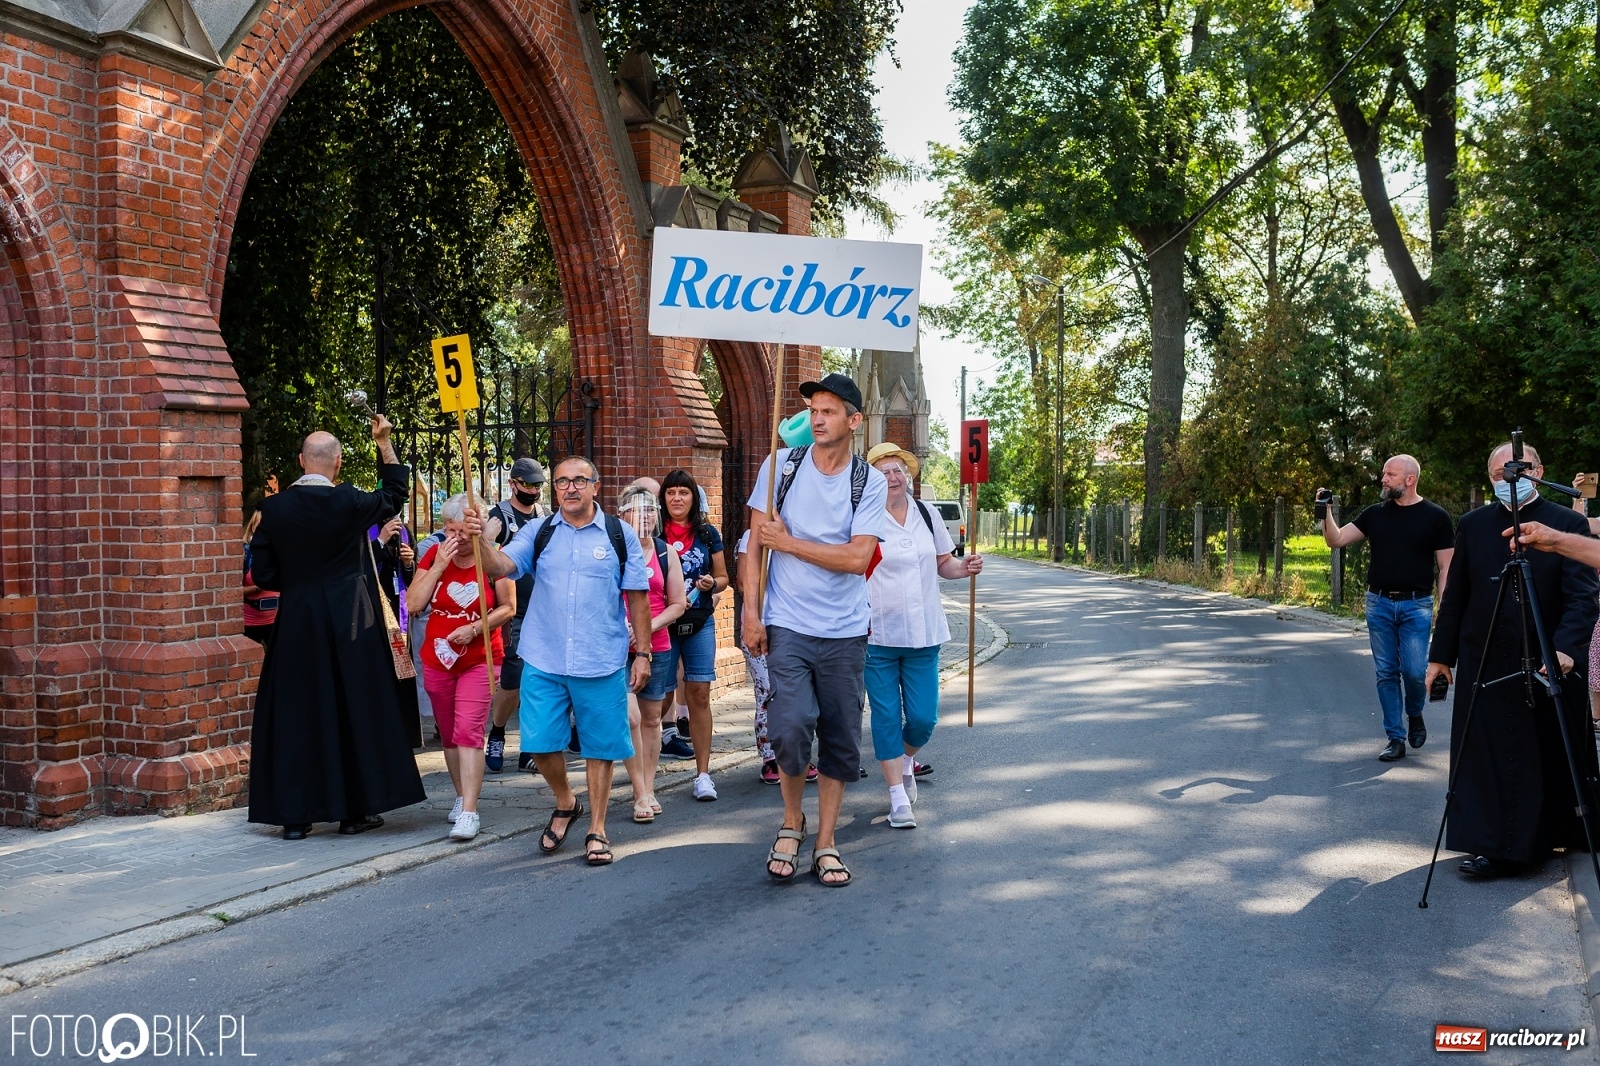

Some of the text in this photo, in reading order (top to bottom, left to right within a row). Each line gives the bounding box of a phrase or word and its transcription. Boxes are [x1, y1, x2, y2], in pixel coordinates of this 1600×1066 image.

[658, 256, 914, 328] Racibórz
[441, 343, 462, 388] 5
[968, 426, 982, 464] 5
[431, 581, 443, 602] I
